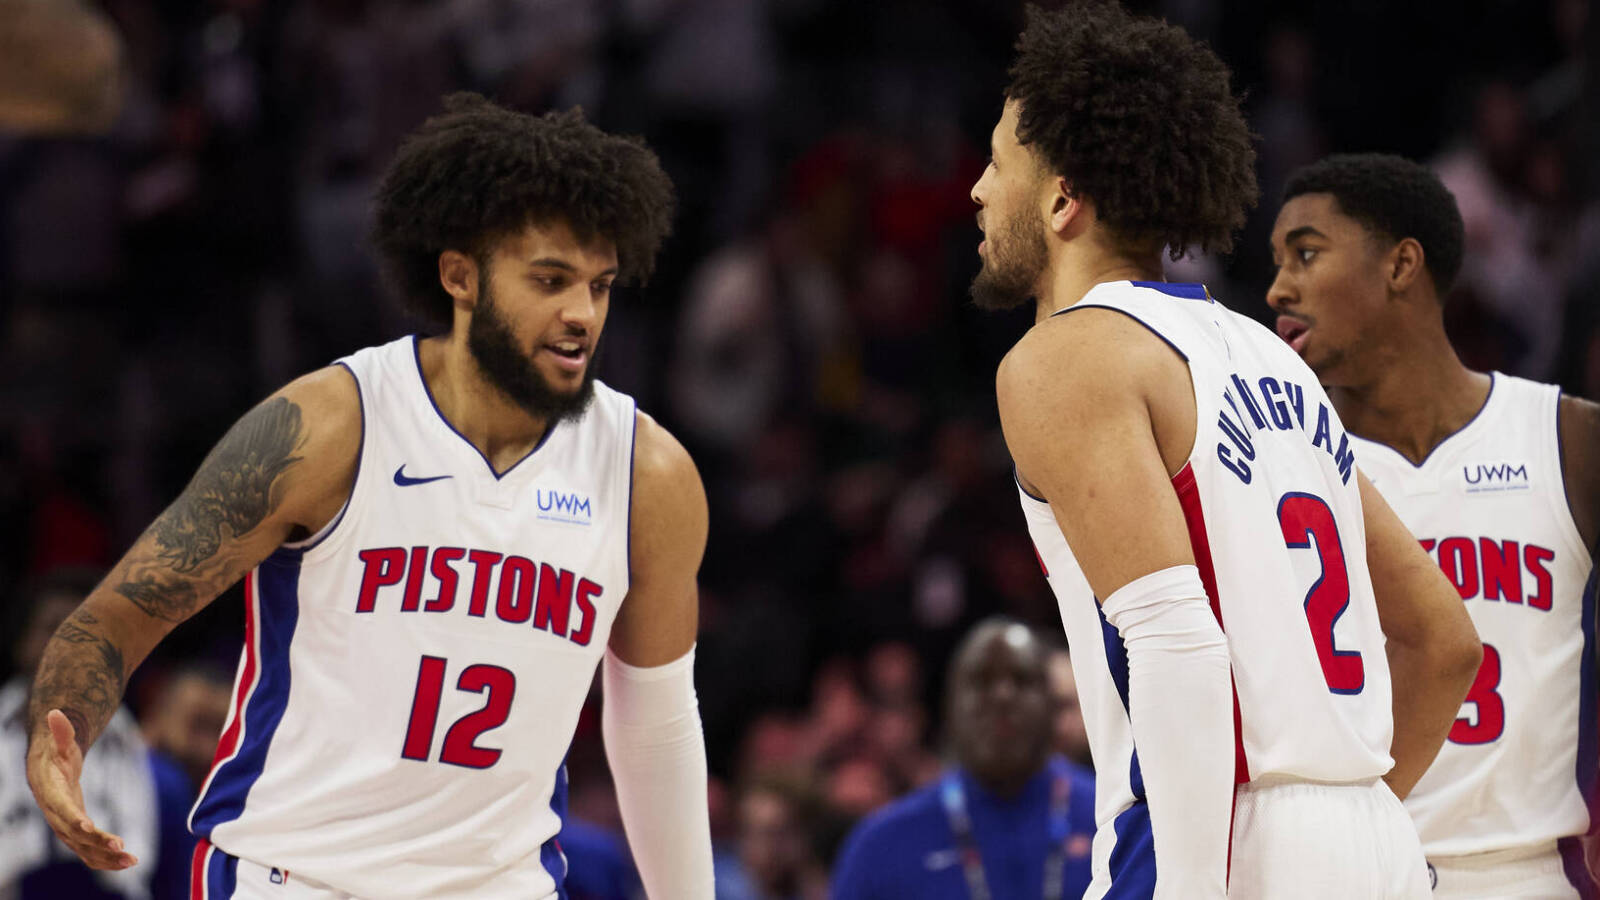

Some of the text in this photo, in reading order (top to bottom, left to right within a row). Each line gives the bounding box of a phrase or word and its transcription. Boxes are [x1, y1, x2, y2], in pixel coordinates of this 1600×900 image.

[537, 489, 591, 517] UWM
[1463, 464, 1527, 484] UWM
[356, 546, 603, 647] PISTONS
[1277, 492, 1365, 695] 2
[1418, 536, 1555, 612] ONS
[401, 655, 516, 770] 12
[1446, 642, 1505, 745] 3
